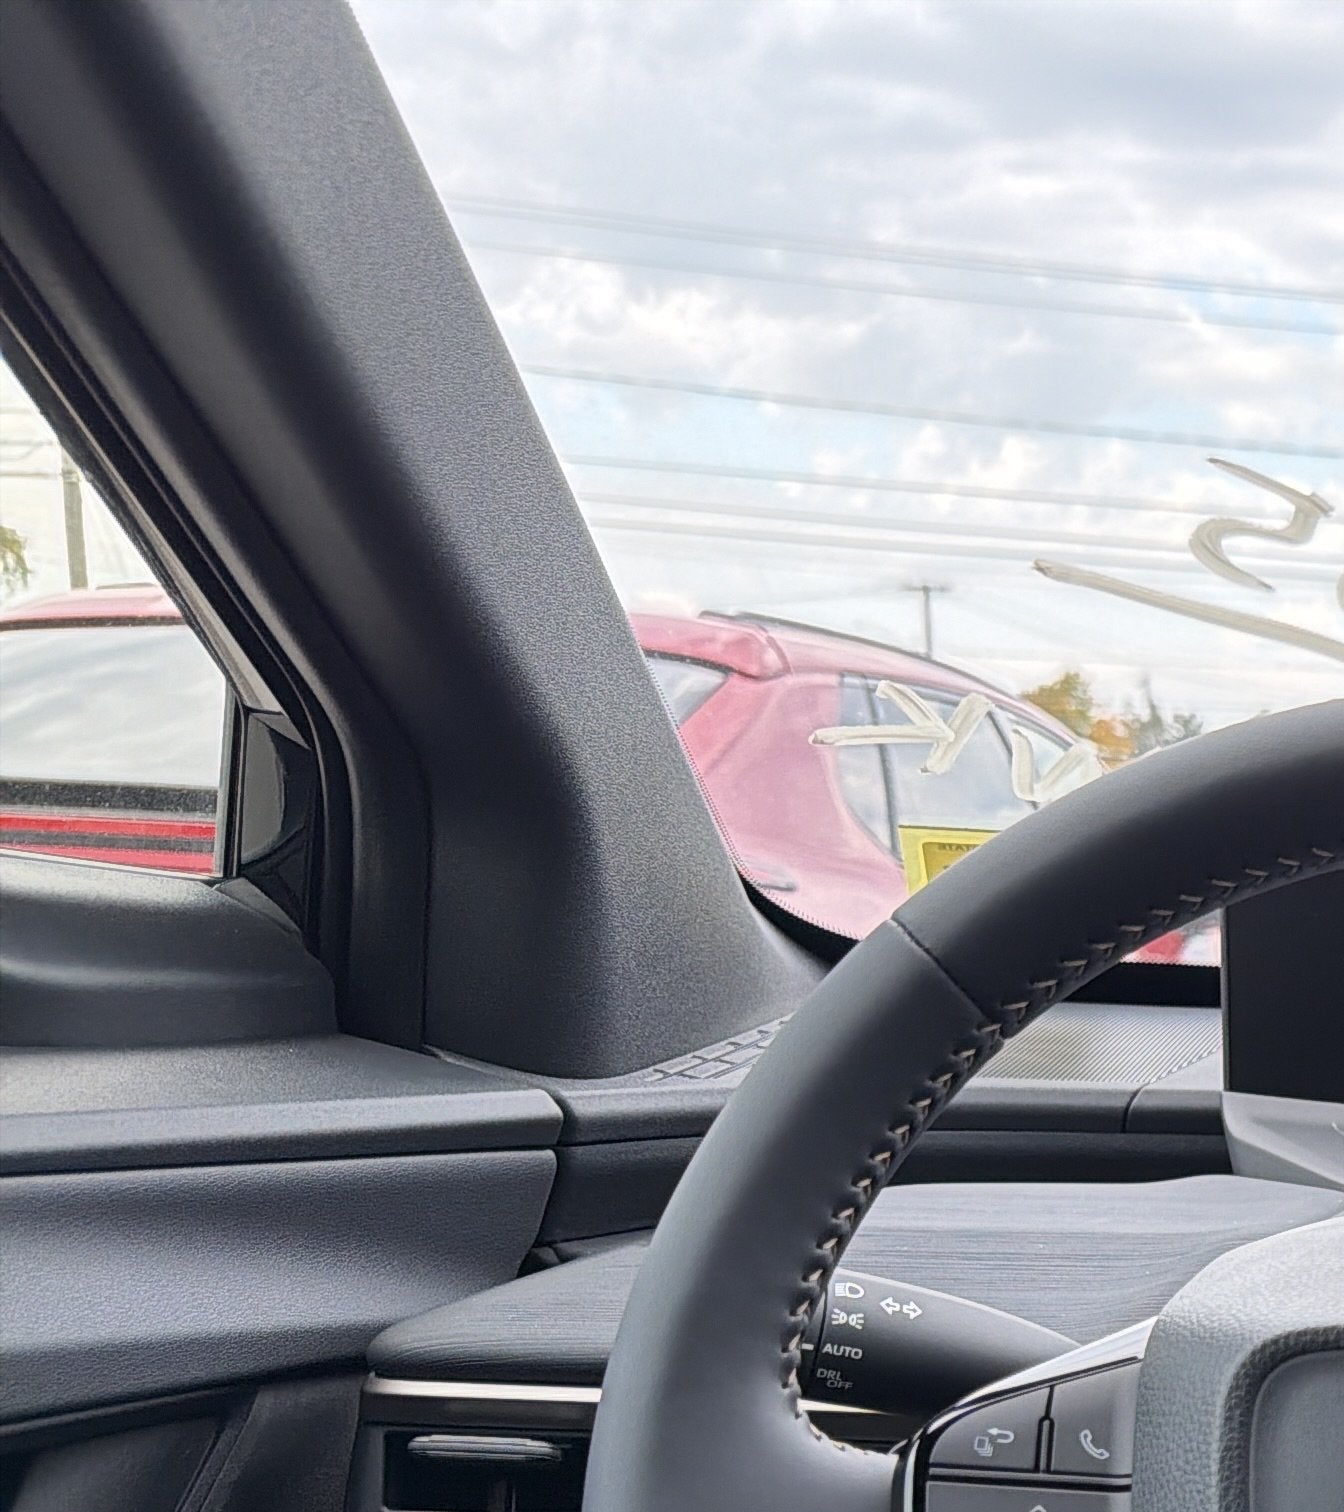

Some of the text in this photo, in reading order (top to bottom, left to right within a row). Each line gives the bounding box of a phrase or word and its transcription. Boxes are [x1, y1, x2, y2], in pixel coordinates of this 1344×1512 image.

[821, 1343, 863, 1360] AUTO
[816, 1368, 842, 1382] DRL
[826, 1379, 854, 1390] OFF
